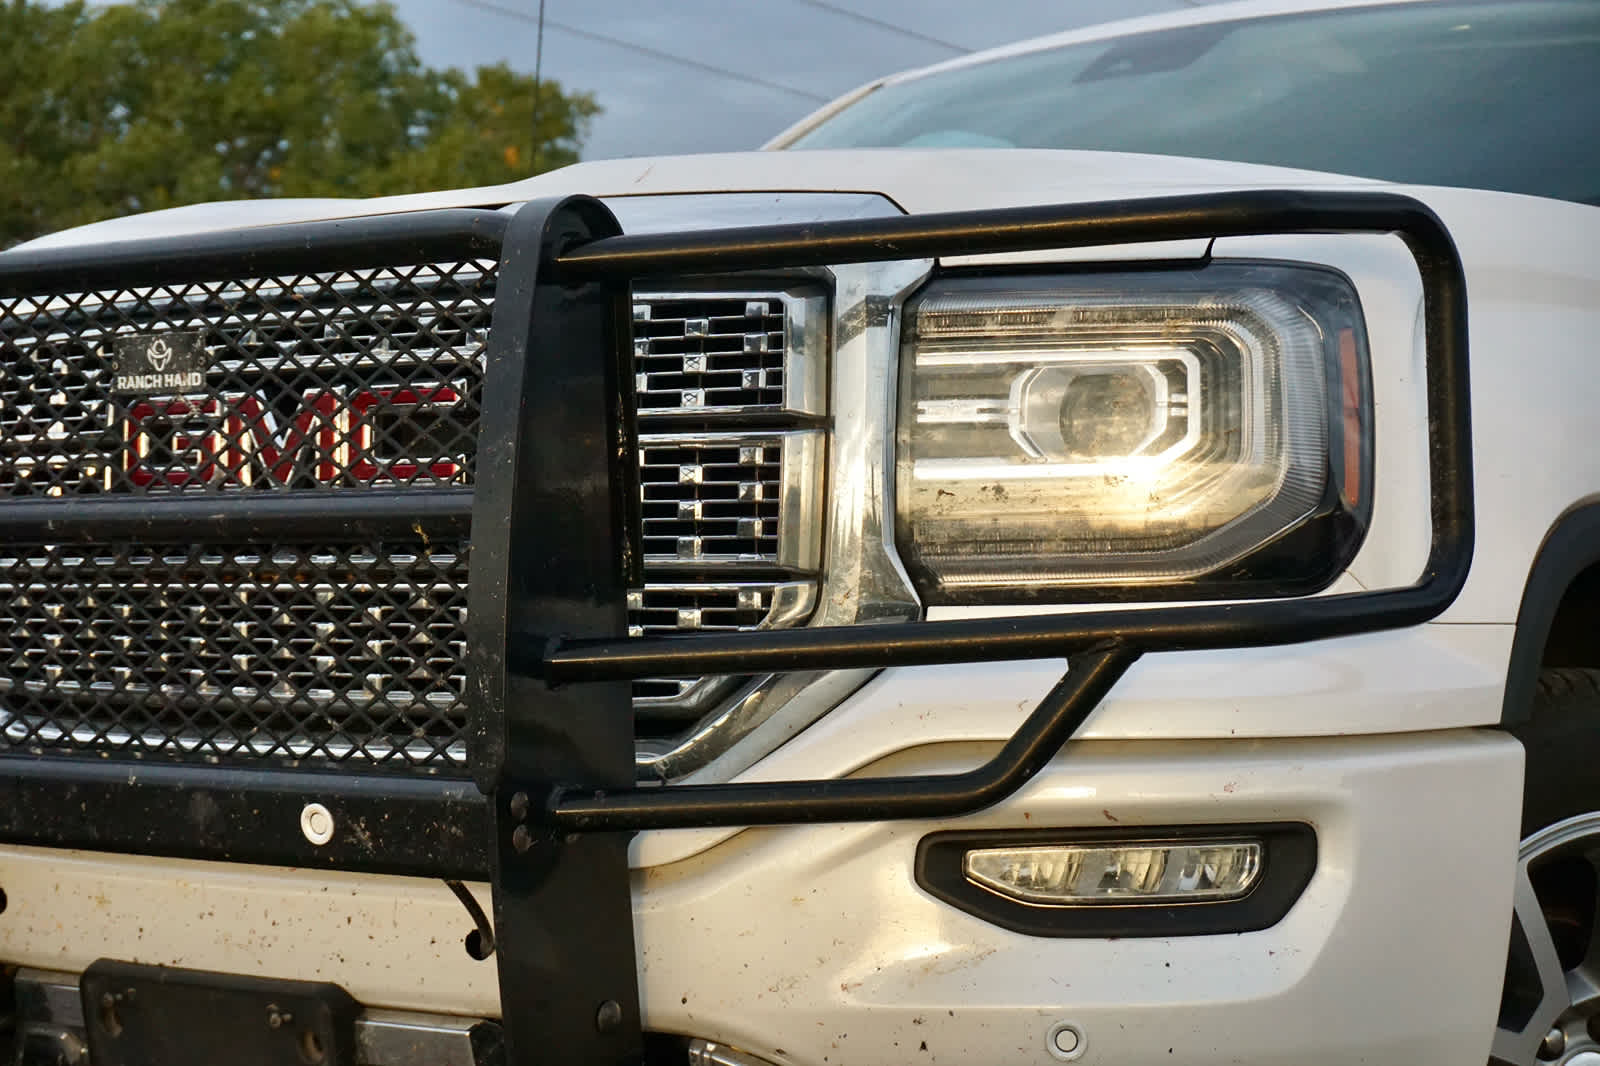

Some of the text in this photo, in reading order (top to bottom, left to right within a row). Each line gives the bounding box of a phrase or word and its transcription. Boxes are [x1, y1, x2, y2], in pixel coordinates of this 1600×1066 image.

[117, 372, 201, 390] RANCH HAND
[123, 379, 467, 491] GMC
